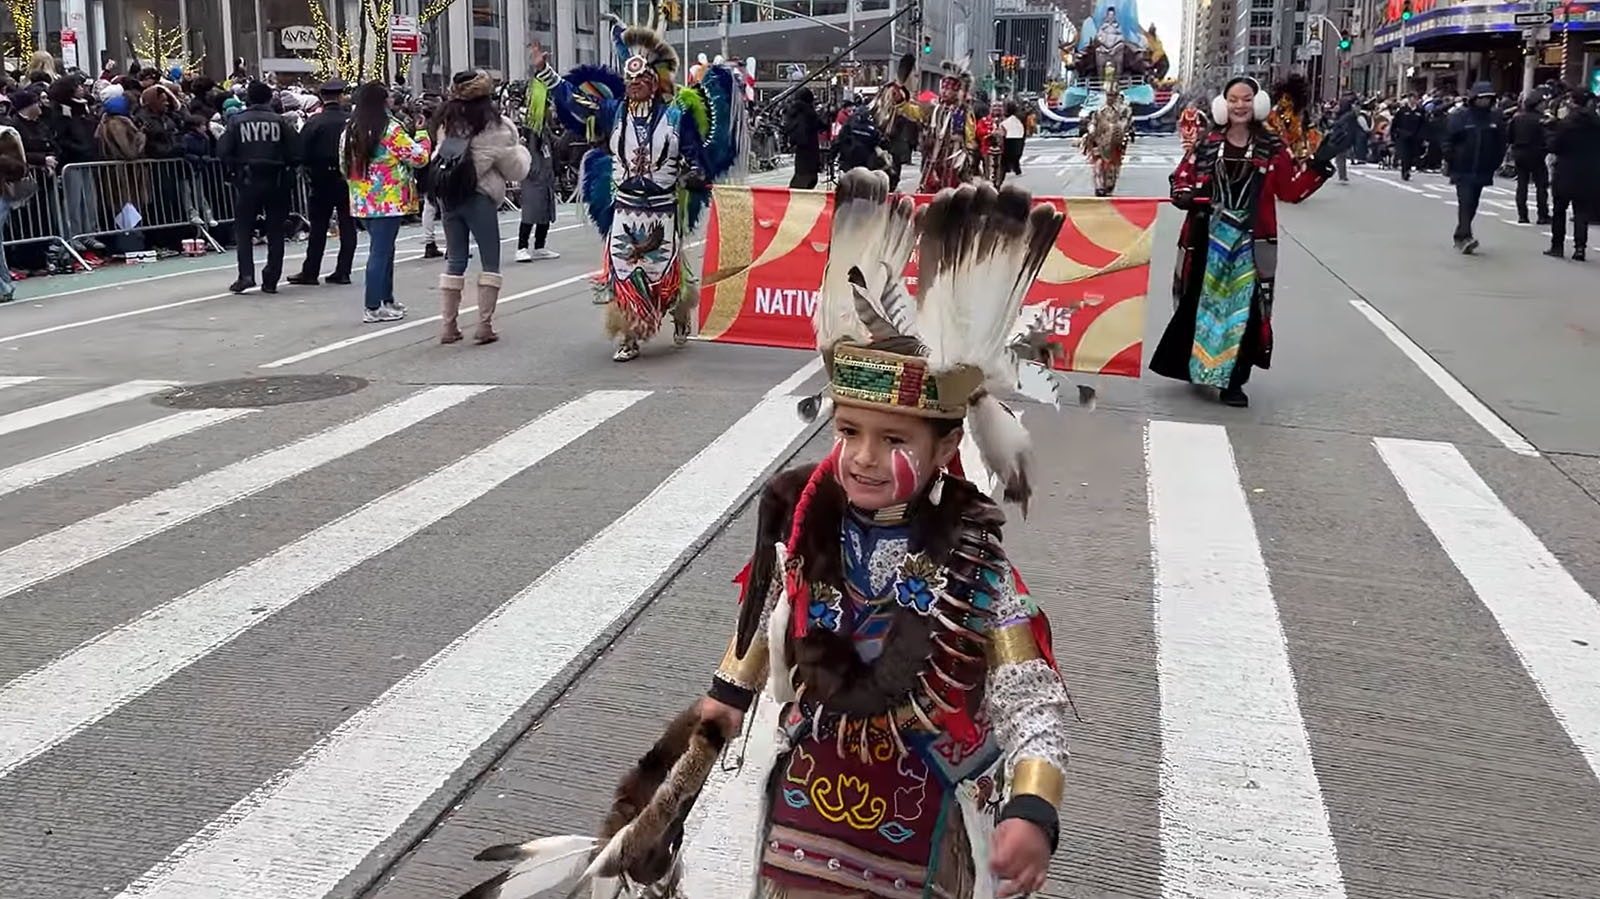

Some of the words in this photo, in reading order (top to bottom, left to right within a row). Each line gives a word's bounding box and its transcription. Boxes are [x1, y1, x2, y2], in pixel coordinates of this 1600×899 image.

[284, 30, 317, 43] AVRA
[240, 121, 281, 143] NYPD
[755, 287, 818, 318] NATIV
